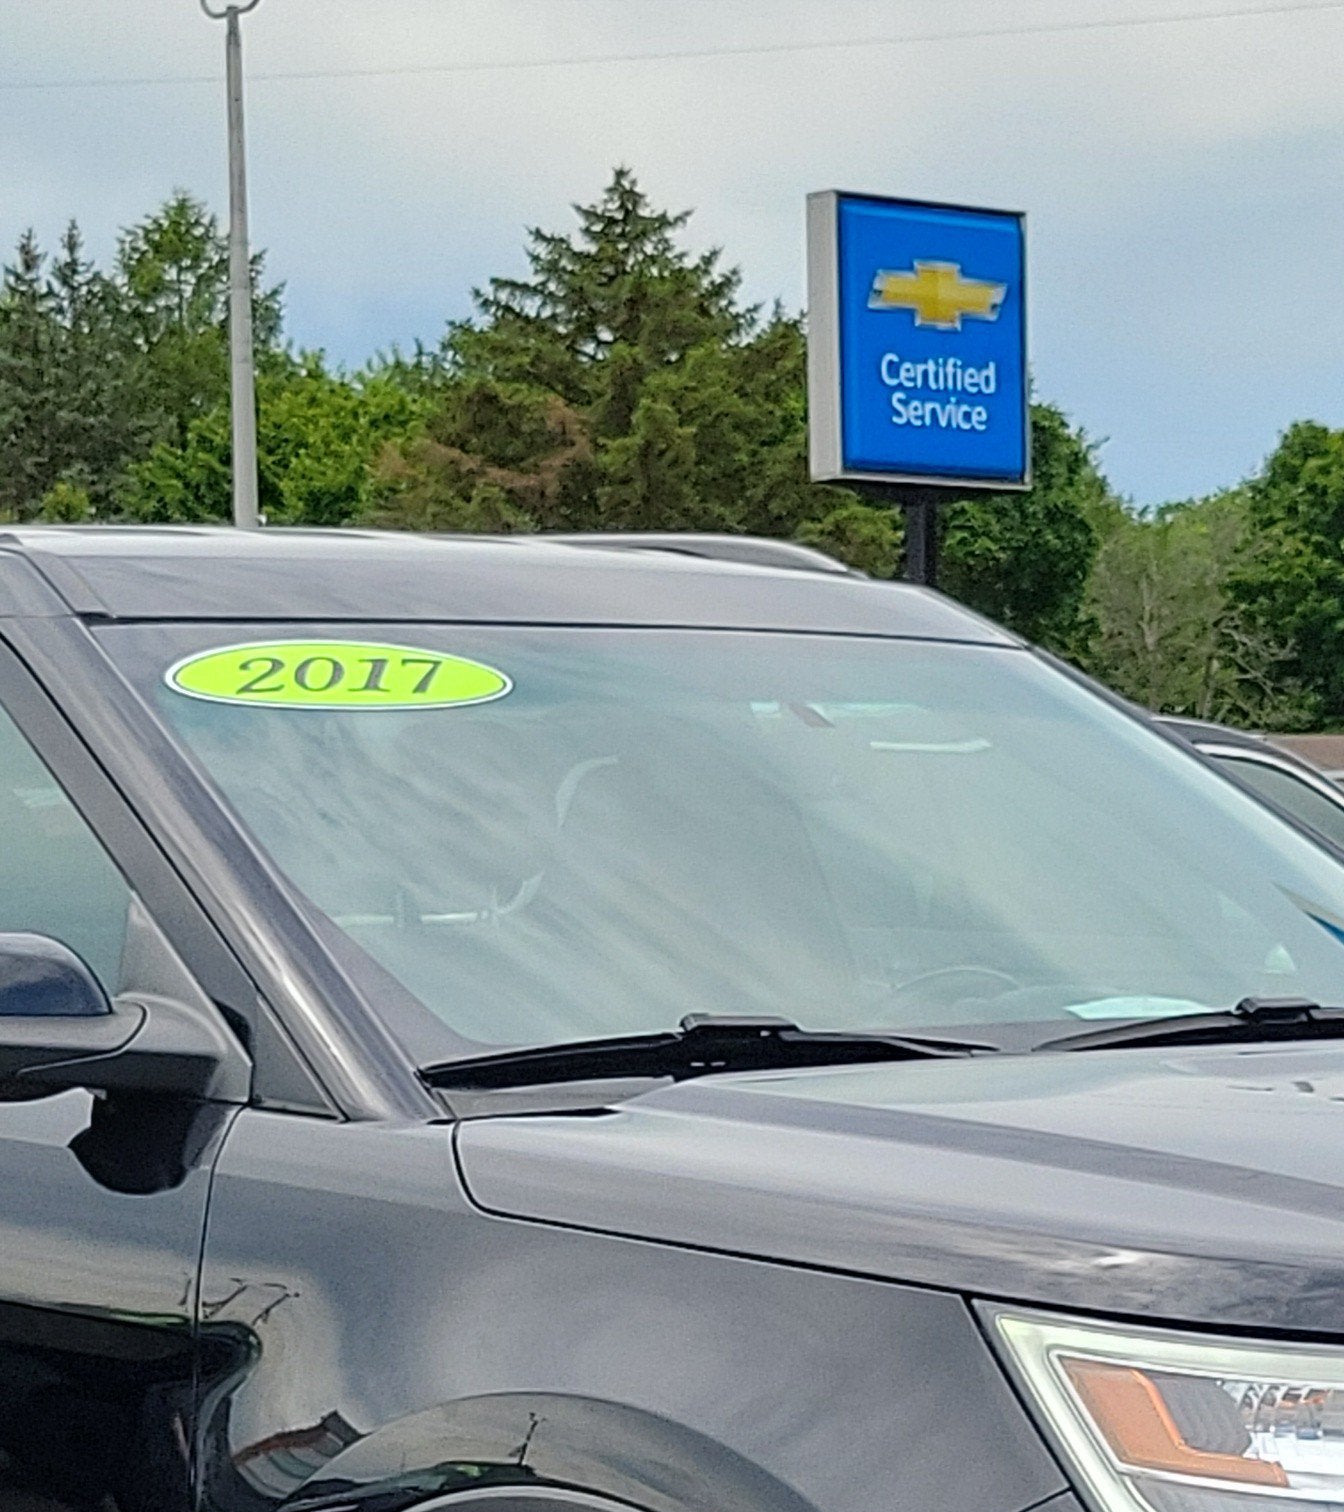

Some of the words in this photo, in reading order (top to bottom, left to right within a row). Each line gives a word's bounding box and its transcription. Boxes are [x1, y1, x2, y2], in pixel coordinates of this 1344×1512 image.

[881, 352, 997, 394] Certified
[891, 391, 988, 431] Service
[235, 656, 442, 695] 2017
